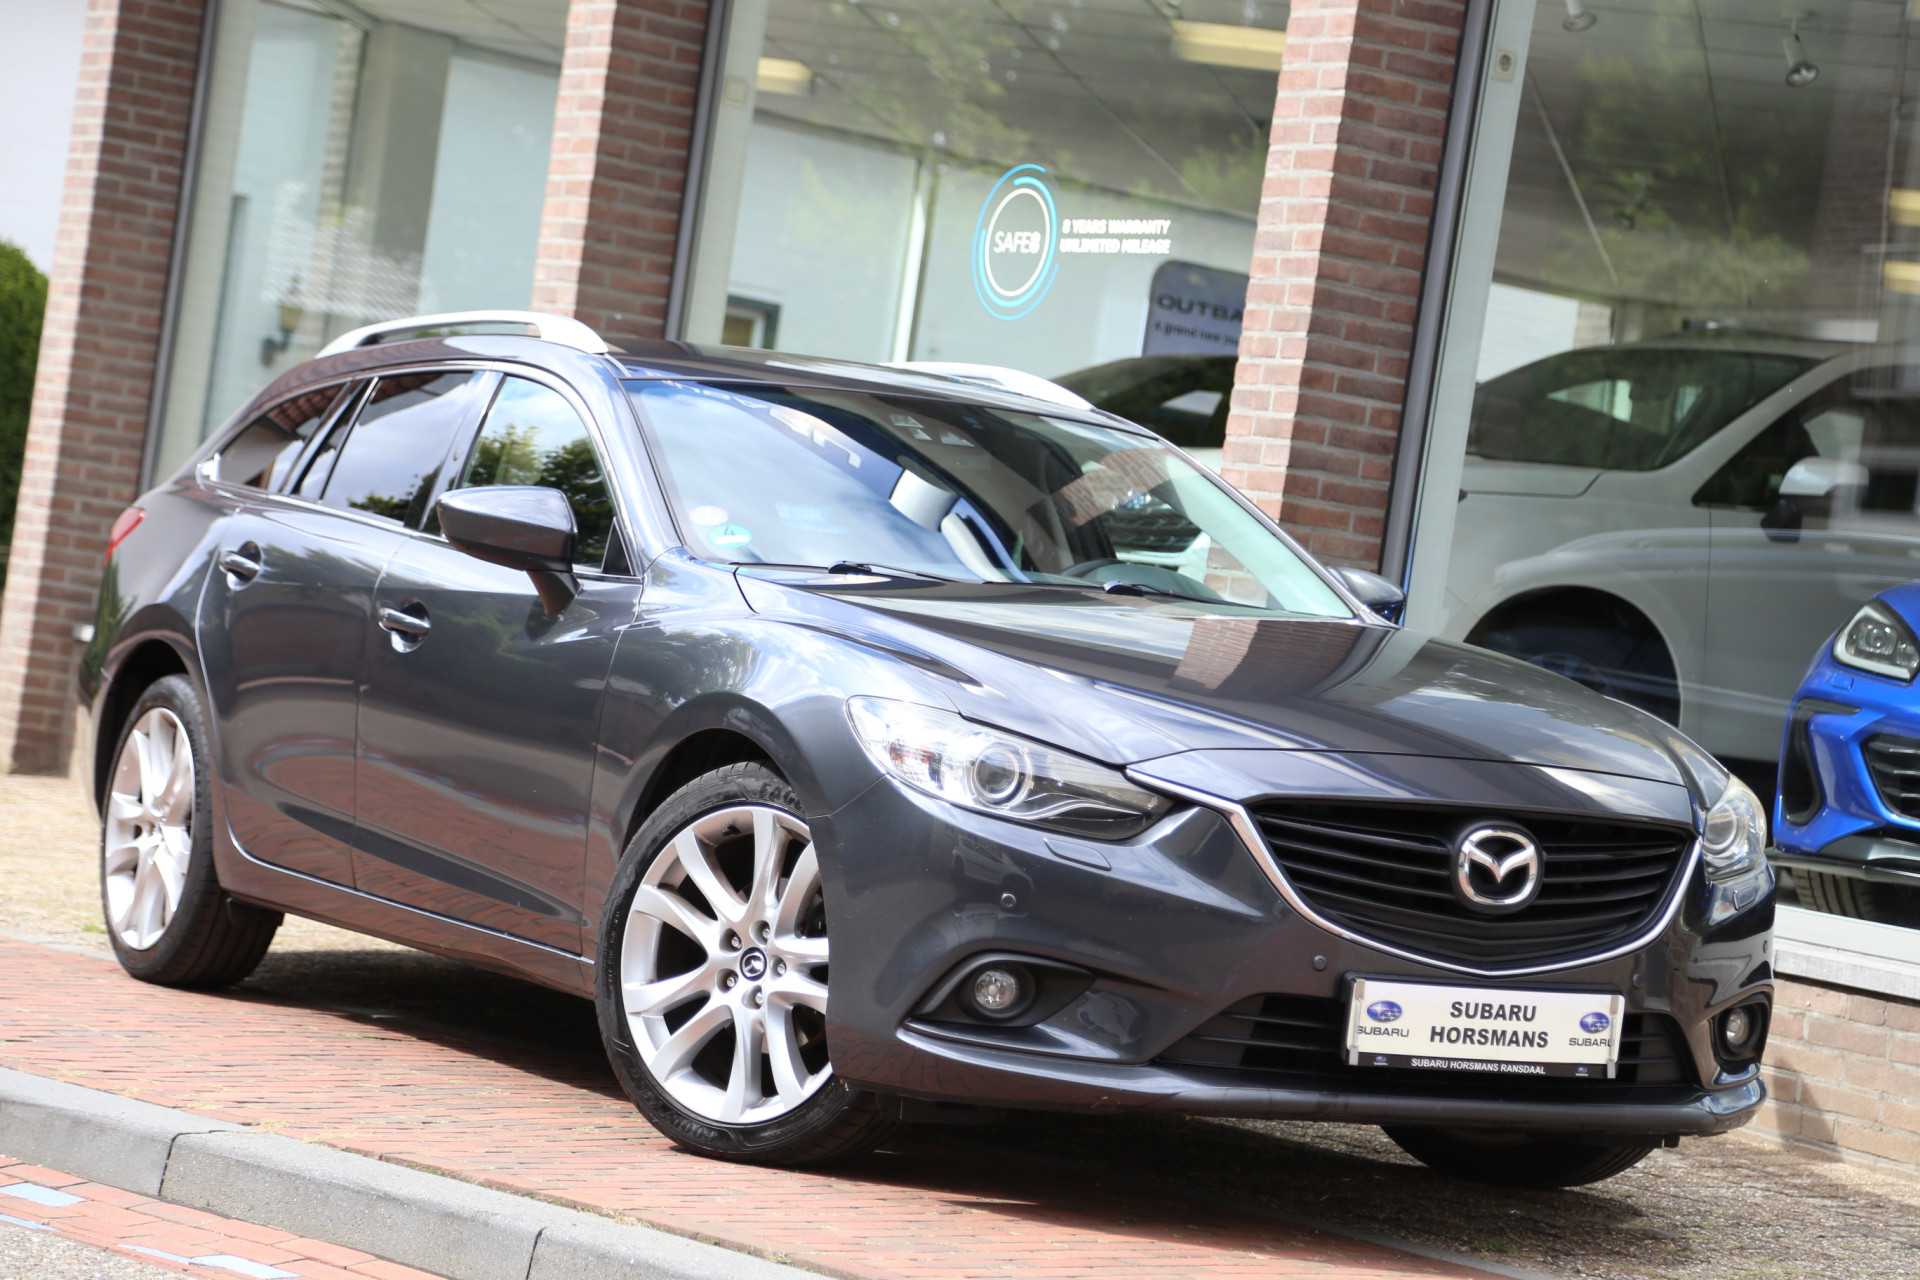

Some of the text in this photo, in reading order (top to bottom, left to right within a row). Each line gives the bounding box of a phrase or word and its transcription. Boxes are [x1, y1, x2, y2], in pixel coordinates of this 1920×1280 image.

[1072, 219, 1107, 234] YEARS
[1108, 219, 1171, 235] WARRANTY
[1060, 238, 1171, 254] UNLIMITED MILEAGE
[1450, 1000, 1537, 1022] SUBARU
[1430, 1026, 1549, 1048] HORSMANS
[1411, 1058, 1546, 1075] SUBARU HORSMANS RANSDAAL
